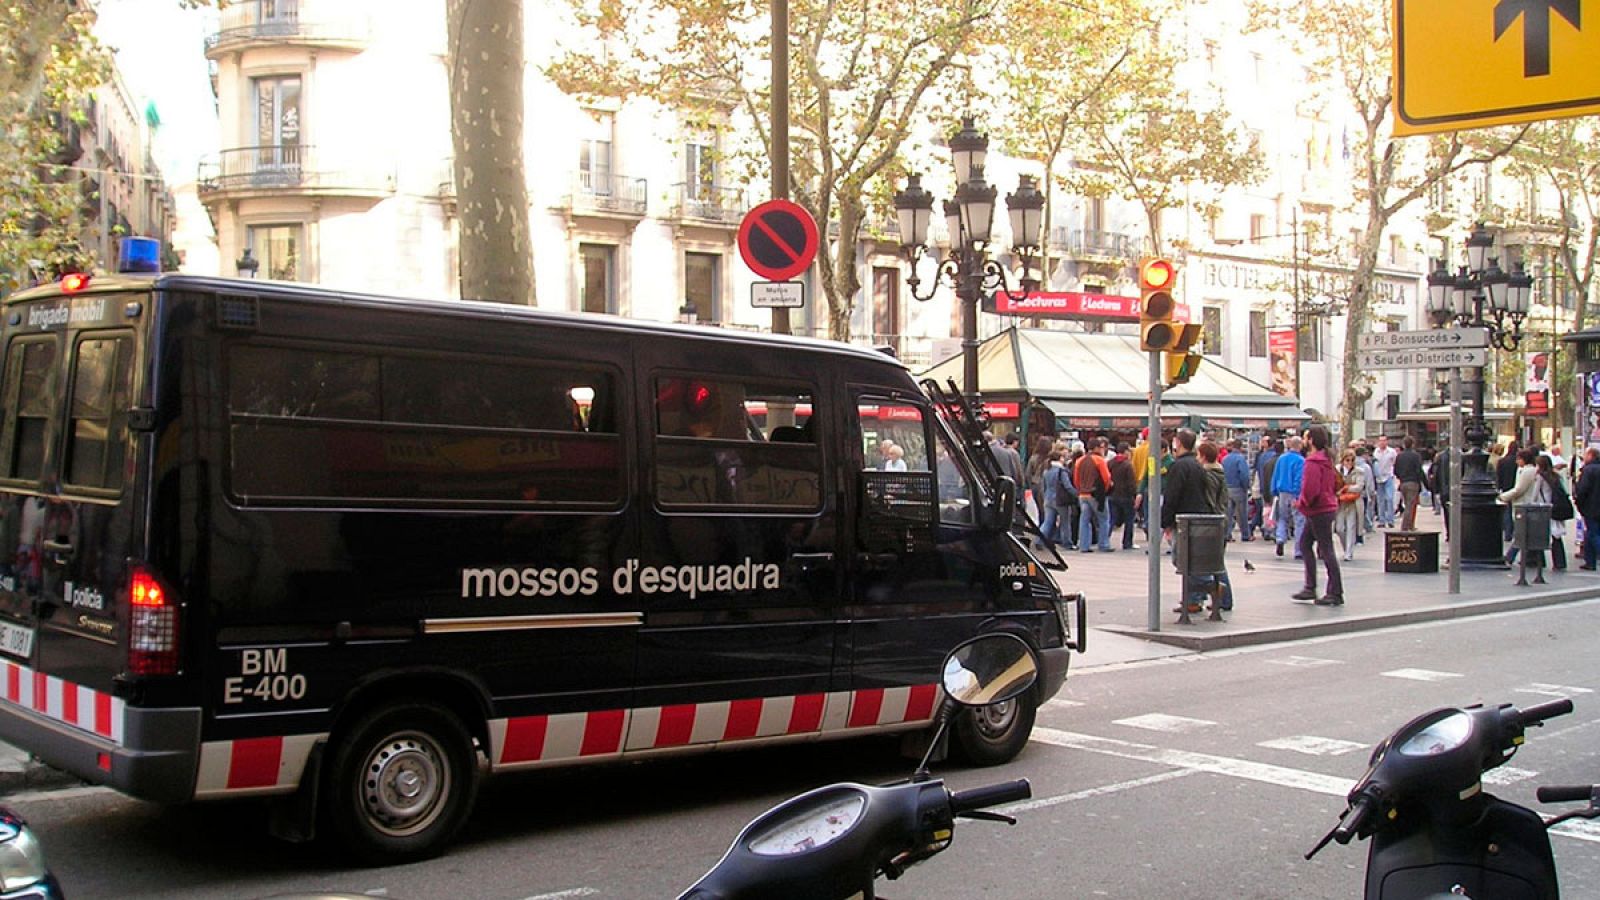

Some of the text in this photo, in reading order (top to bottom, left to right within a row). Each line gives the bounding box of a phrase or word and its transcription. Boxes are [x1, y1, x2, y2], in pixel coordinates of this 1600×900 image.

[1203, 263, 1264, 291] HOTEL
[28, 299, 105, 330] brigada mobil
[1391, 332, 1449, 344] Bonsuccés
[1374, 350, 1461, 365] Seu del Districte
[461, 556, 780, 600] mossos d'esquadra
[1000, 562, 1028, 579] policia
[73, 587, 103, 610] policia
[241, 648, 287, 675] BM
[224, 674, 306, 704] E-400
